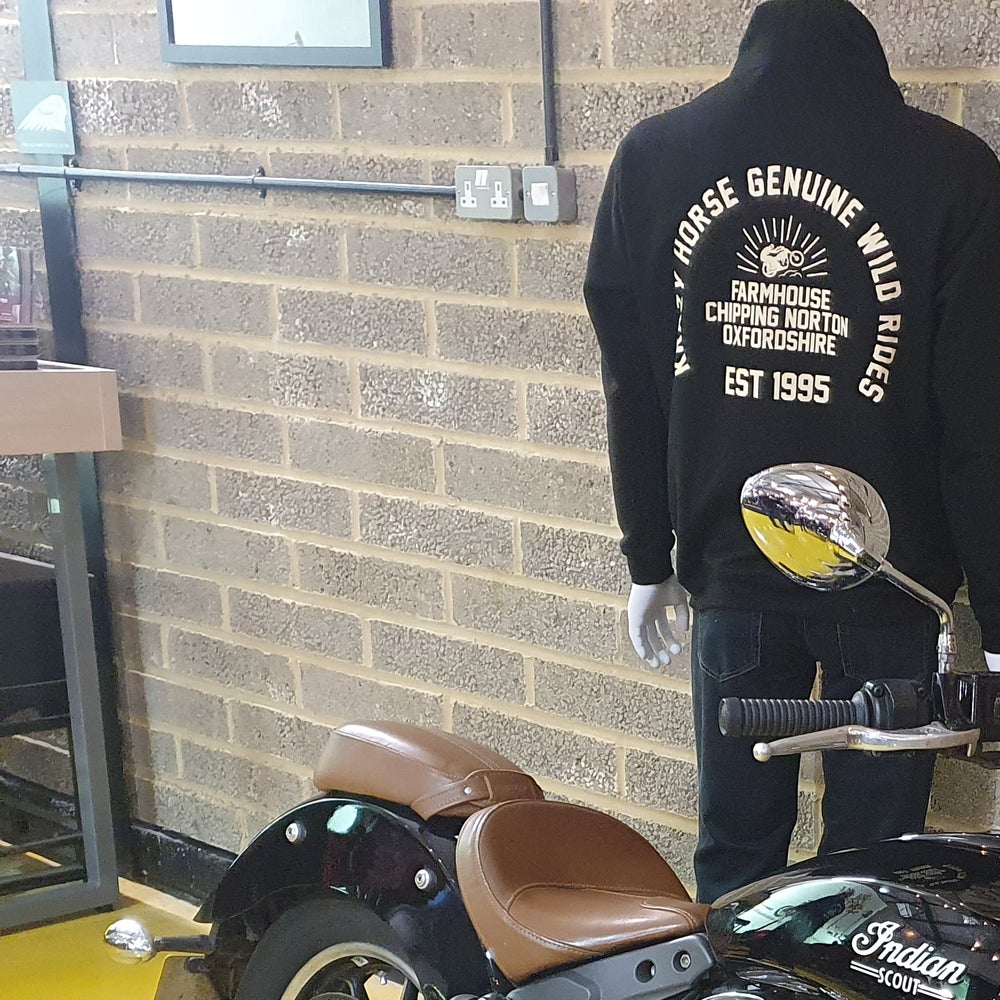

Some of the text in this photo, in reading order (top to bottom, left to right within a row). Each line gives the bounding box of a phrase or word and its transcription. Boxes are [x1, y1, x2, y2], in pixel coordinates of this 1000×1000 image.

[674, 176, 740, 266] HORSE
[746, 164, 865, 228] GENUINE
[856, 222, 902, 303] WILD
[705, 301, 849, 338] CHIPPING NORTON
[731, 279, 831, 310] FARMHOUSE
[722, 323, 837, 356] OXFORDSHIRE
[858, 314, 901, 403] RIDES
[724, 366, 831, 404] EST 1995
[851, 920, 967, 985] Indian
[877, 966, 921, 996] SCOUT
